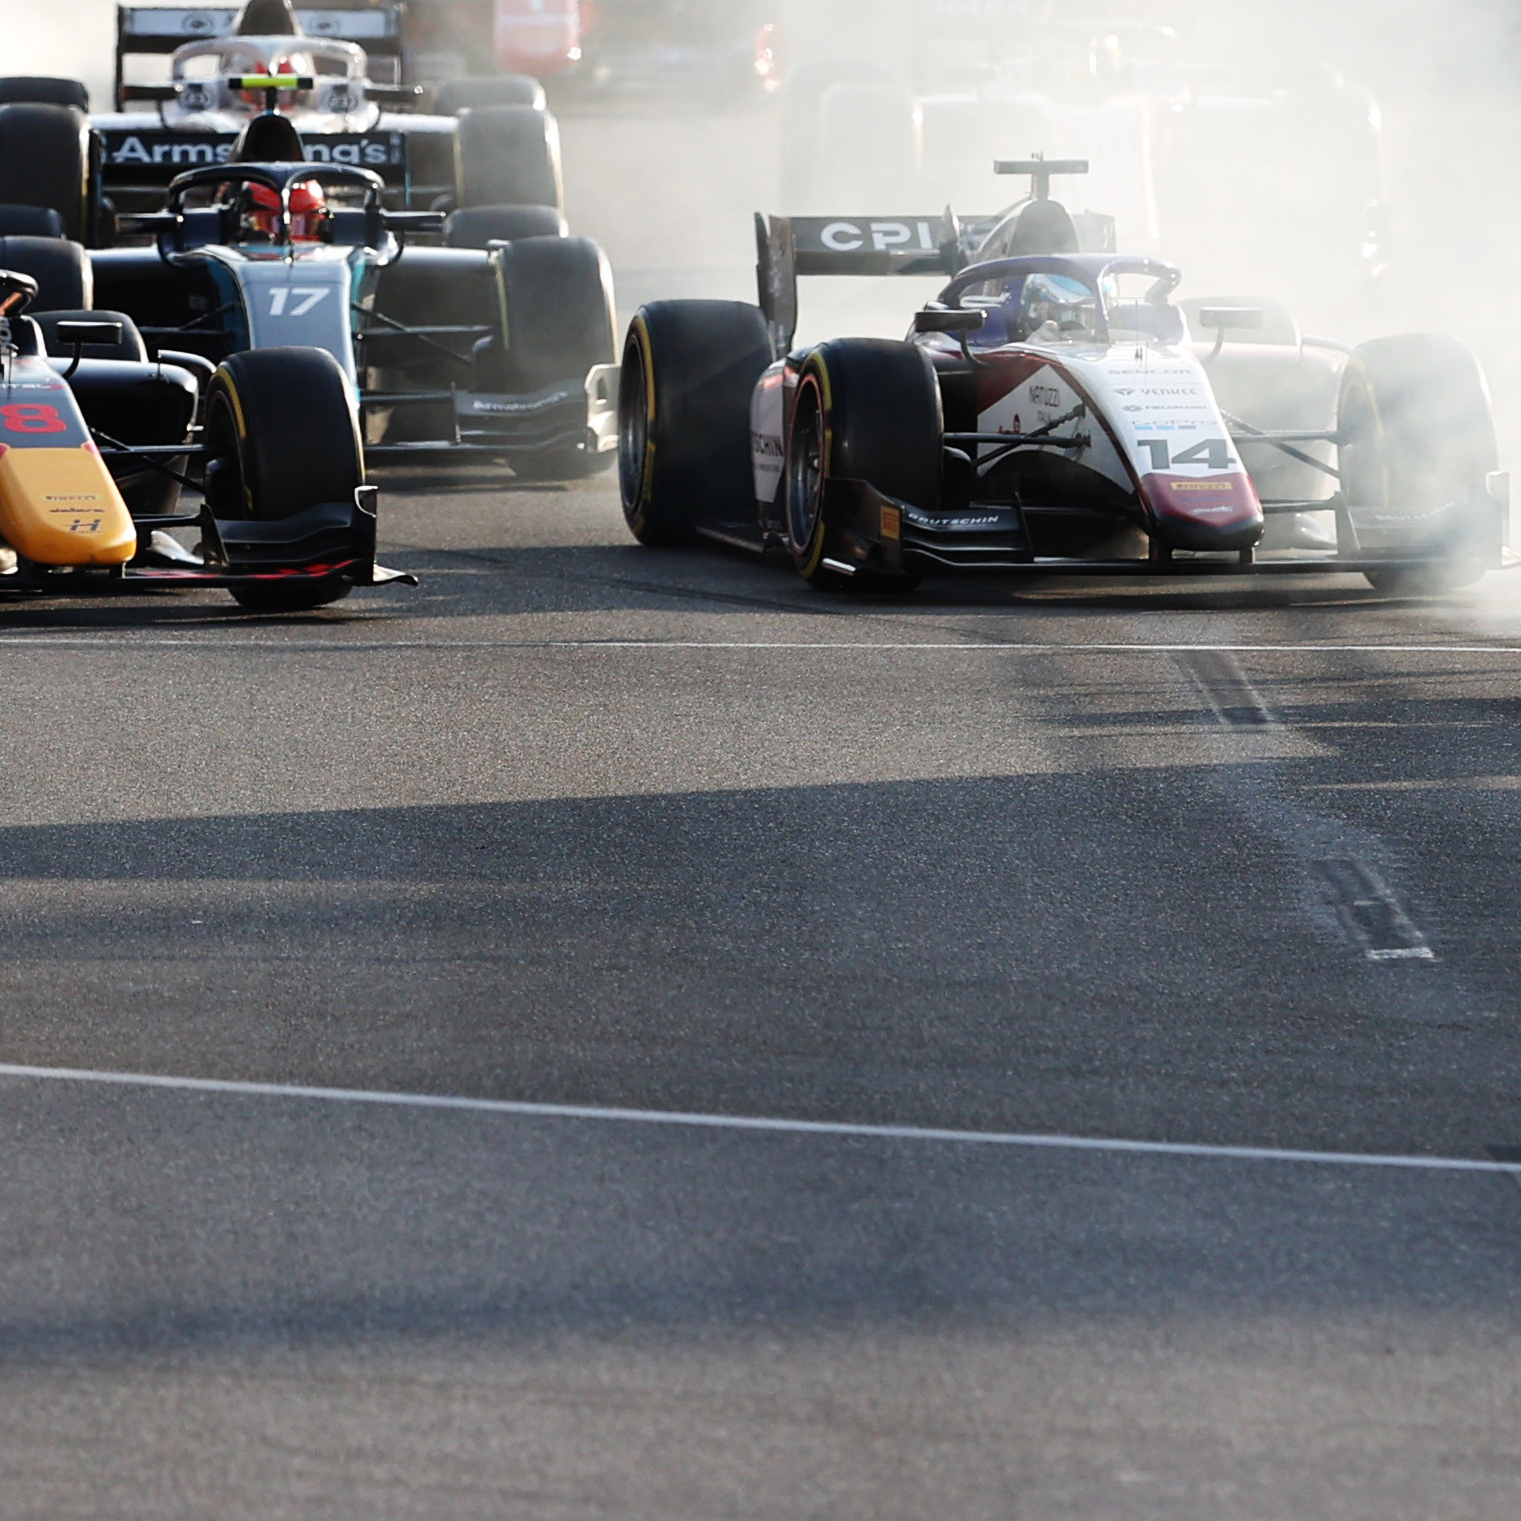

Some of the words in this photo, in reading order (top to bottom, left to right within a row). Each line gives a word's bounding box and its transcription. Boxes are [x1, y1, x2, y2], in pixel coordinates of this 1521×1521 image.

[112, 135, 386, 166] Armsng's
[820, 222, 934, 251] CPI
[268, 287, 331, 317] 17
[0, 403, 67, 434] 8
[1137, 439, 1237, 470] 14
[907, 512, 1000, 526] BRUTSCHIN
